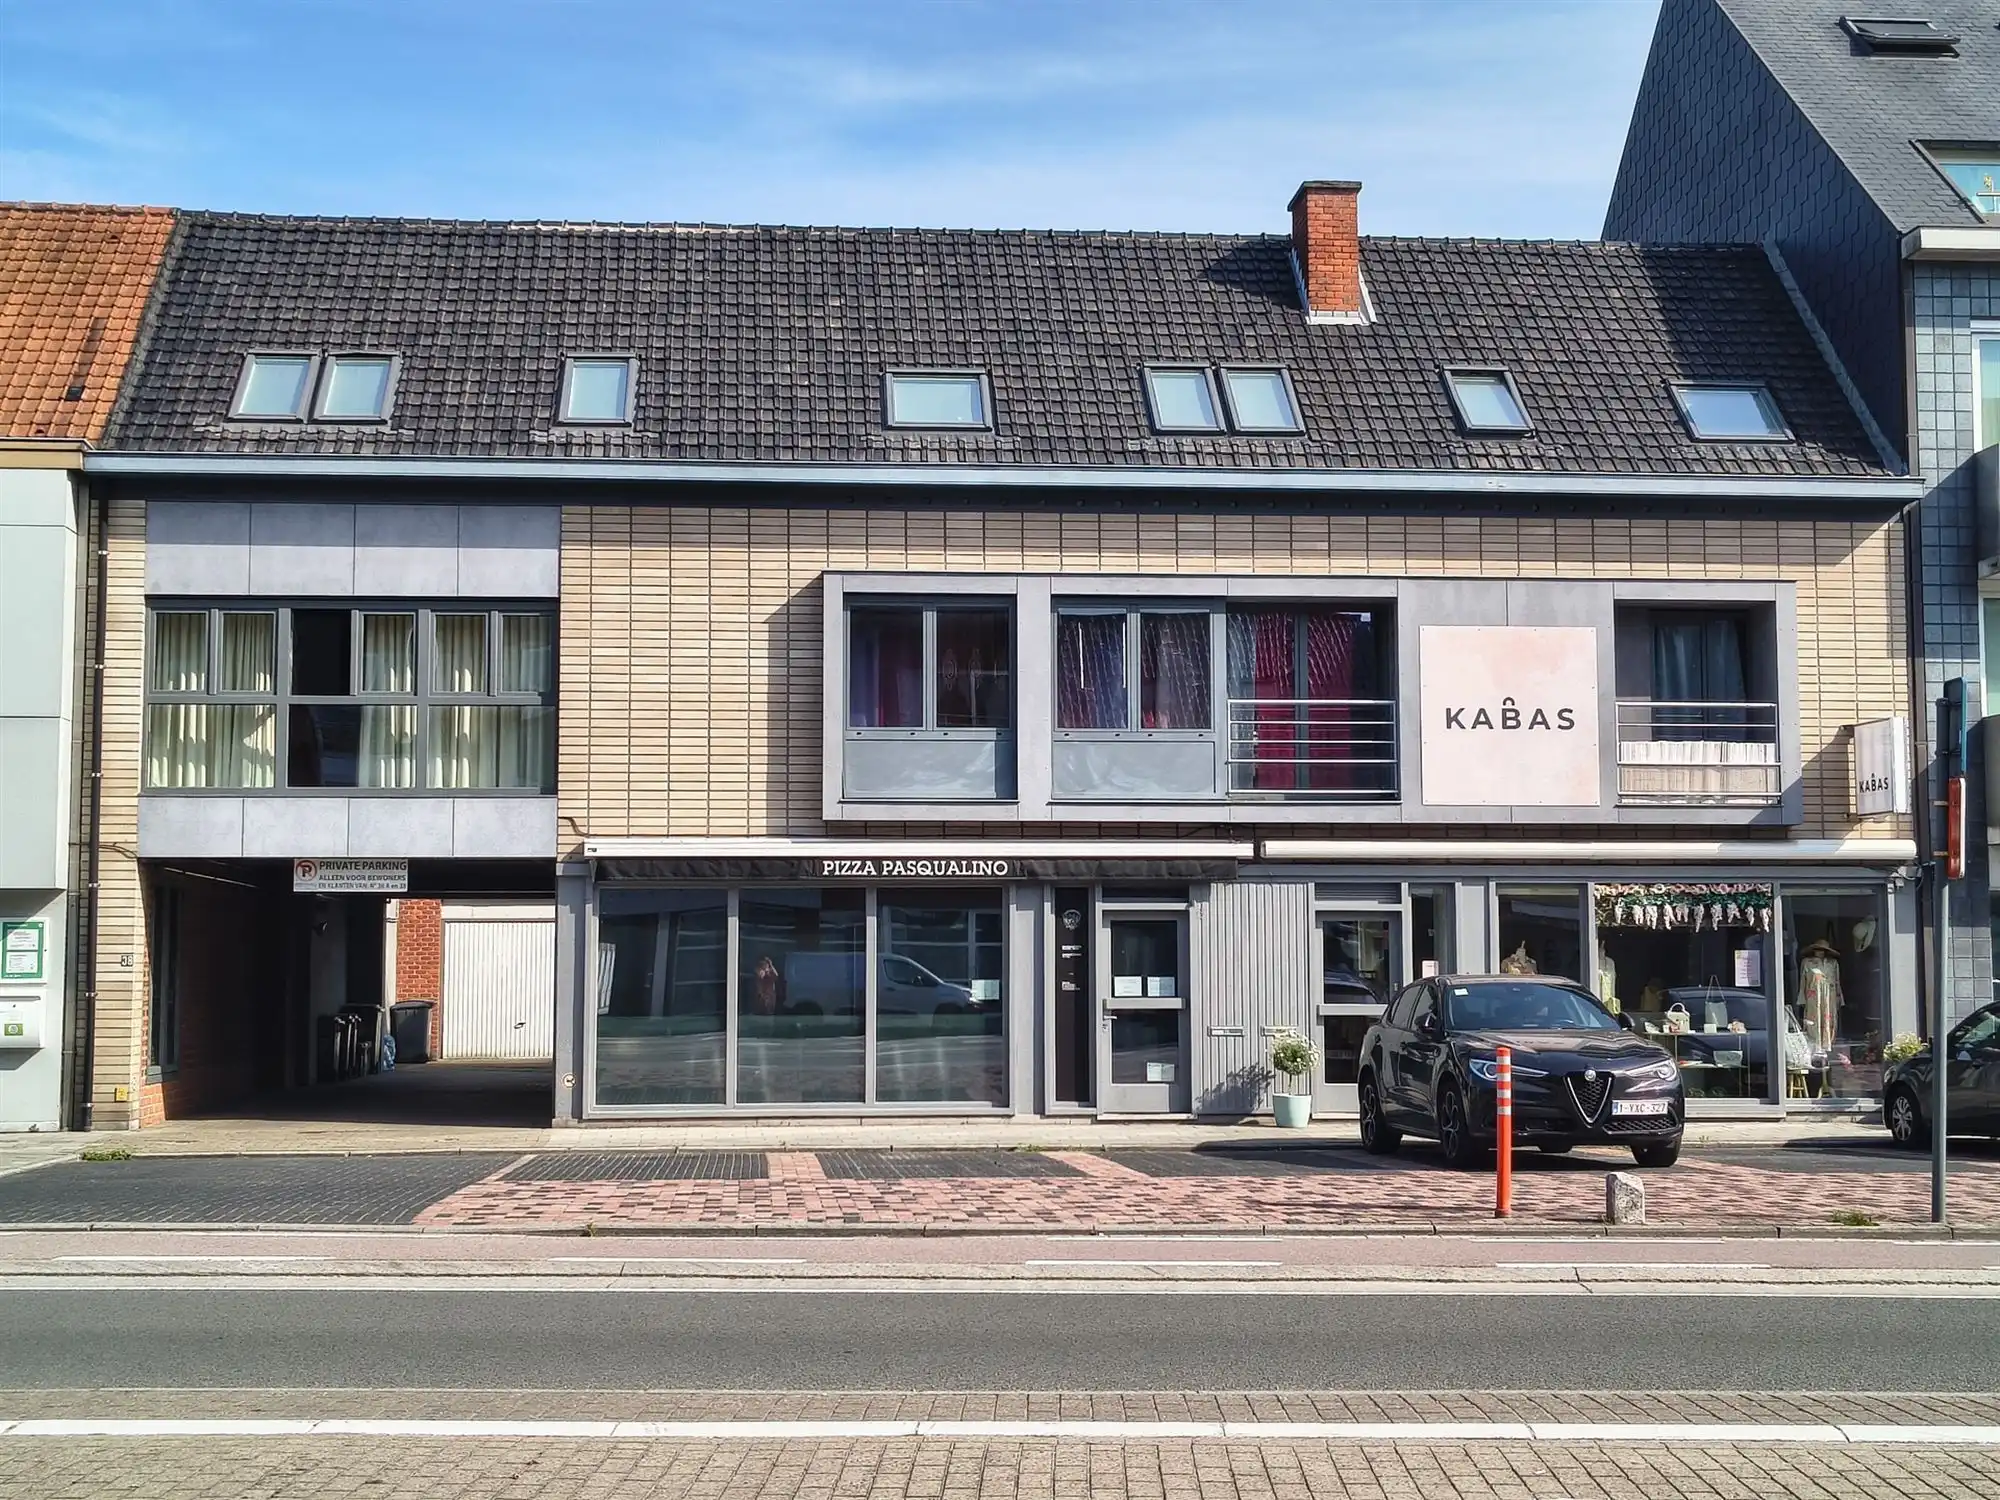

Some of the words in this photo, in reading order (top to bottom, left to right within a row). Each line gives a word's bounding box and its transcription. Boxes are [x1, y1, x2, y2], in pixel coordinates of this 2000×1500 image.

[1445, 696, 1575, 730] KABAS
[1859, 772, 1889, 793] KABAS
[319, 861, 361, 870] PRIVATE
[362, 861, 407, 870] PARKING
[822, 860, 877, 876] PIZZA
[882, 860, 1008, 876] PASQUALINO
[121, 955, 133, 967] 38
[1619, 1103, 1666, 1113] 1-YXC-327
